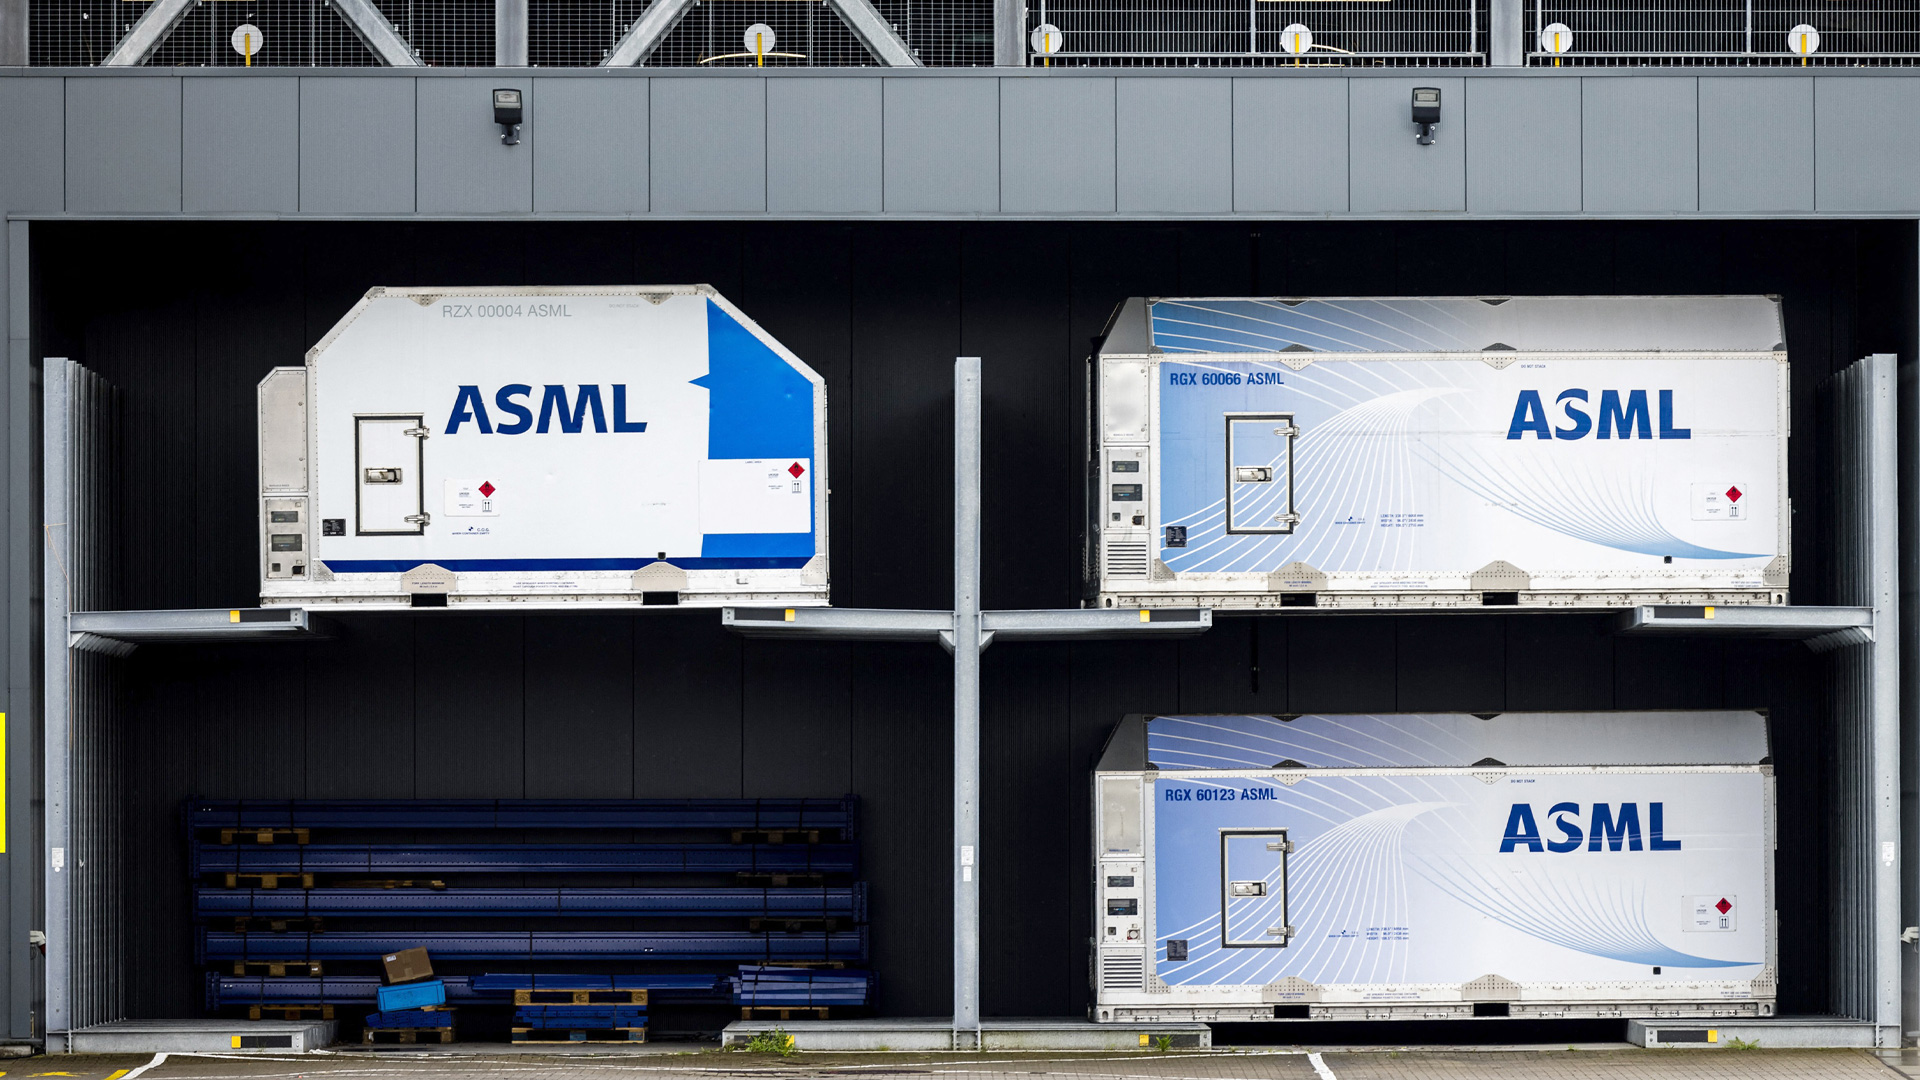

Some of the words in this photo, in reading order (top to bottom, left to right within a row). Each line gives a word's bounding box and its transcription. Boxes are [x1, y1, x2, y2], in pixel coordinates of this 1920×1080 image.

[443, 305, 473, 318] RZX
[477, 304, 523, 317] 00004
[527, 304, 572, 317] ASML
[1170, 372, 1197, 386] RGX
[1202, 372, 1241, 386] 60066
[1246, 372, 1284, 385] ASML
[444, 384, 648, 435] ASML
[1506, 388, 1691, 440] ASML
[1166, 789, 1192, 801] RGX
[1196, 789, 1235, 801] 60123
[1240, 788, 1278, 800] ASML
[1498, 802, 1682, 853] ASML
